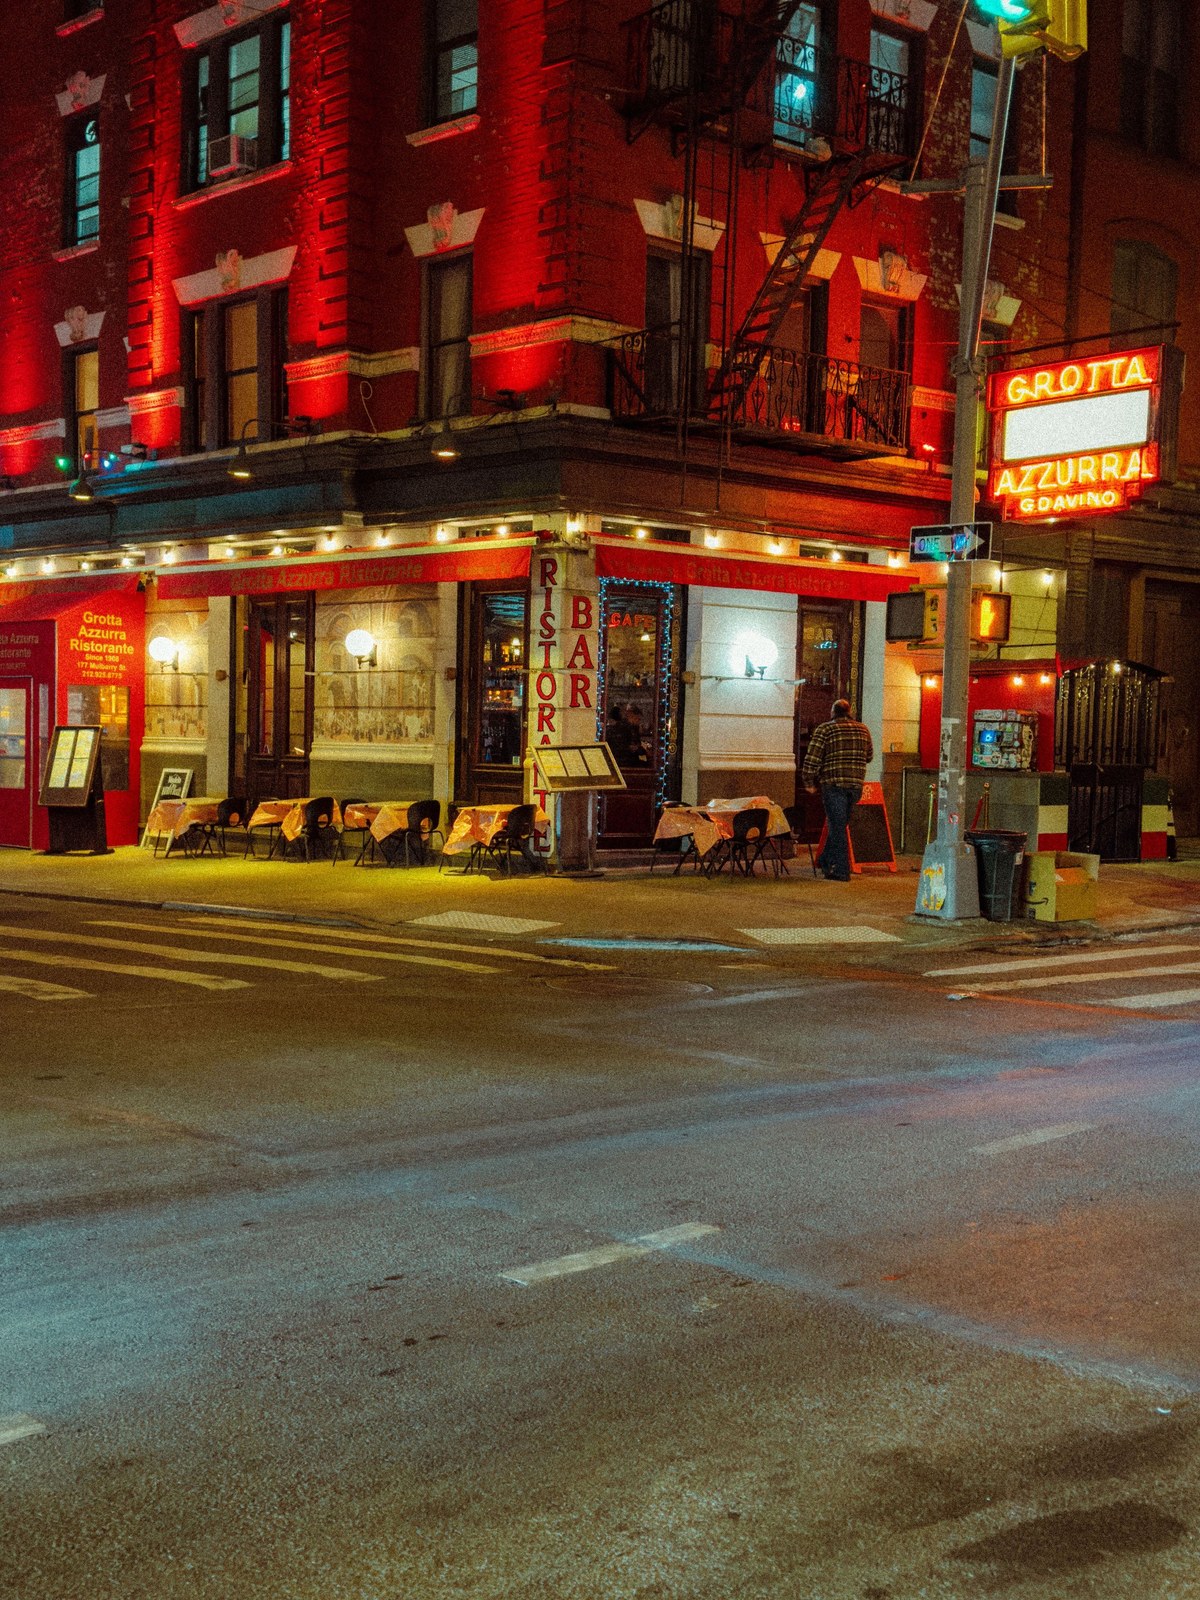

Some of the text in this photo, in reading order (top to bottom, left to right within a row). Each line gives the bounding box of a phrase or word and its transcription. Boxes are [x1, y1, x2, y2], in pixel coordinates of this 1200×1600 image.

[1008, 356, 1153, 402] GROTTA
[994, 451, 1154, 497] AZZURRA
[277, 569, 334, 588] Azzurra
[339, 562, 423, 584] Ristorante
[83, 611, 123, 626] Grotta
[78, 625, 127, 640] Azzurra
[69, 638, 135, 655] Ristorante
[567, 595, 595, 708] BAR
[85, 653, 103, 661] Since
[89, 662, 117, 671] Mulberry
